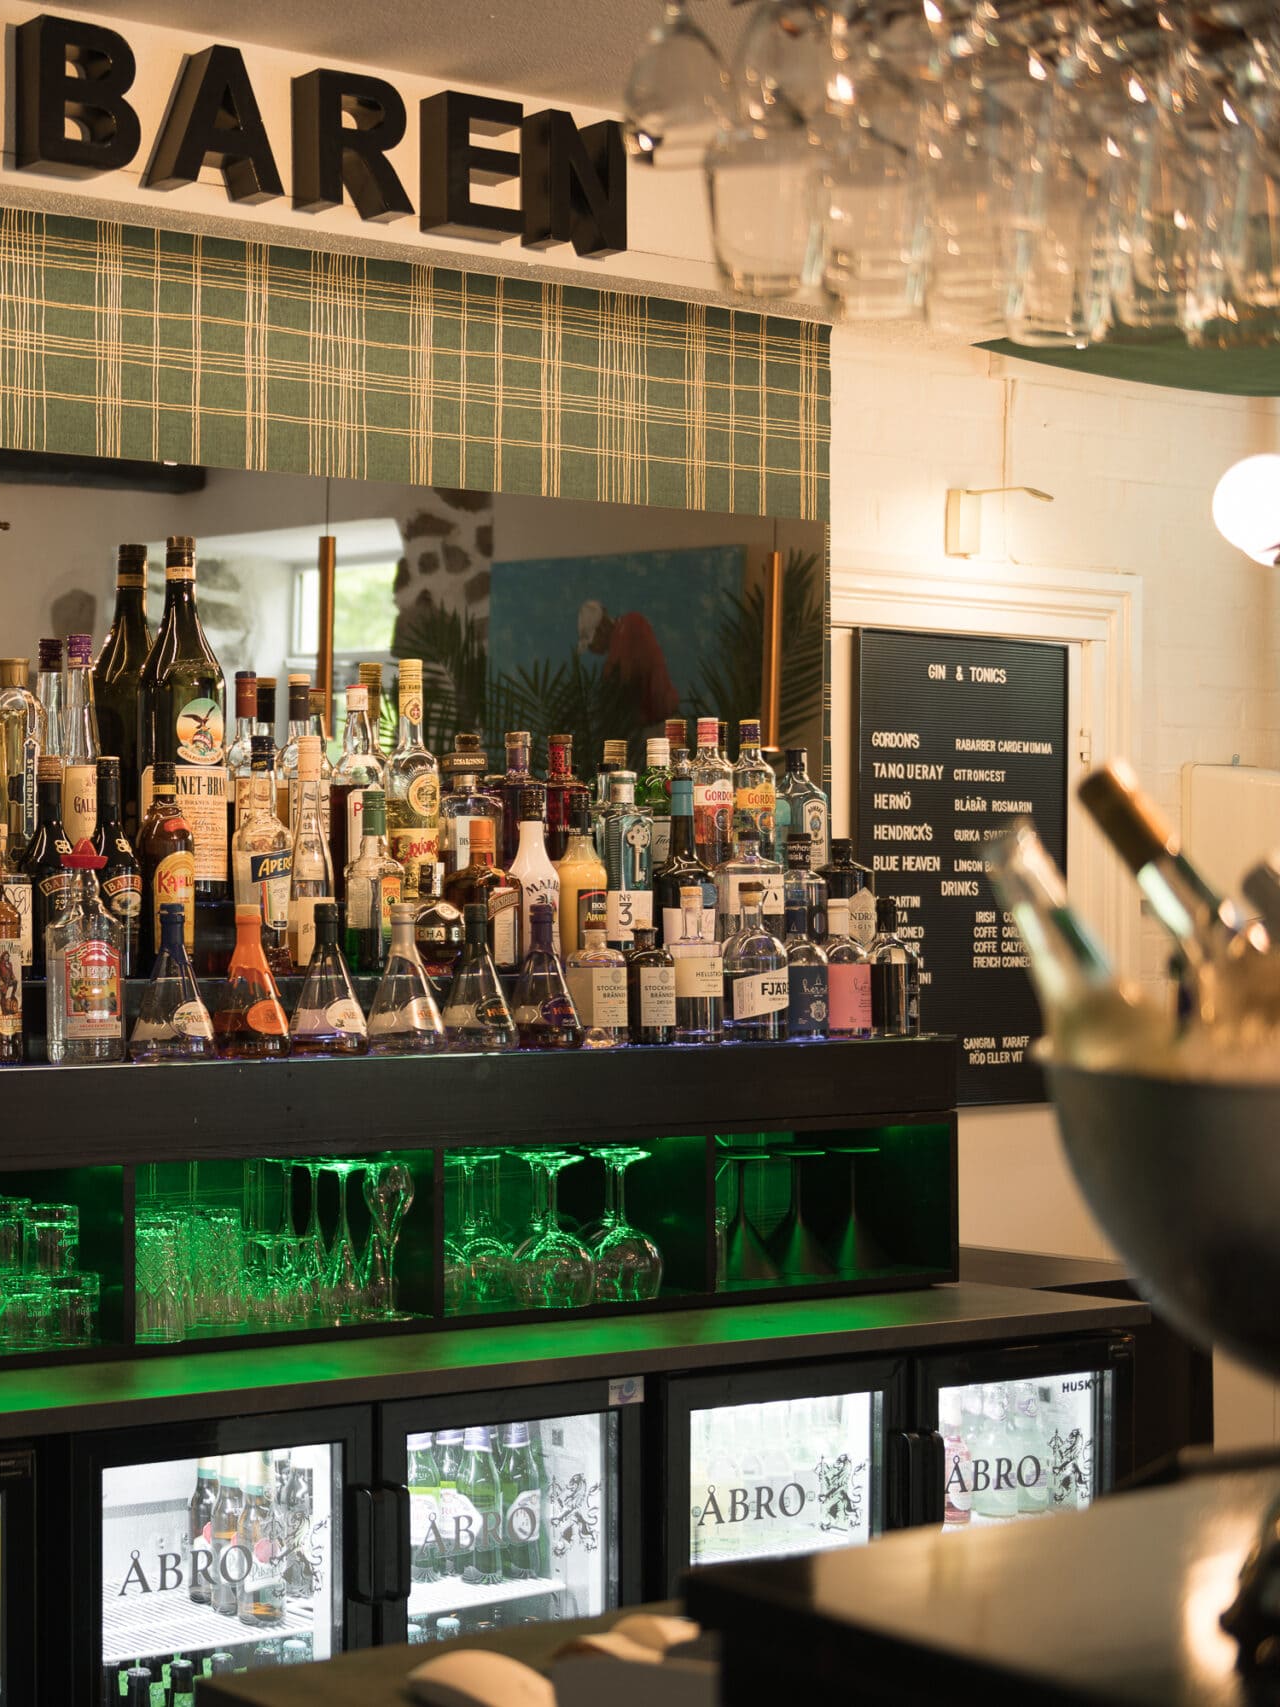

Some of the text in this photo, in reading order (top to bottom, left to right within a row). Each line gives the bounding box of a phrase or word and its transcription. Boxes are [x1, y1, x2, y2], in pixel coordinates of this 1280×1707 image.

[15, 13, 628, 258] BAREN
[928, 664, 1007, 684] GIN & TONICS
[955, 738, 996, 752] RABARBER
[874, 791, 912, 810] HERNÖ
[954, 829, 981, 842] GURKA
[873, 855, 941, 872] BLUE HEAVEN
[941, 881, 979, 897] DRINKS
[618, 902, 633, 926] 3
[976, 911, 996, 923] IRISH
[973, 926, 998, 938] COFFE
[973, 941, 997, 953] COFFE
[973, 956, 1001, 968] FRENCH
[963, 1036, 996, 1049] SANGRIA
[969, 1050, 986, 1065] RÖD
[987, 1052, 1010, 1064] ELLER
[944, 1454, 1041, 1494] ÅBRO
[697, 1482, 806, 1526] ÅBRO
[417, 1506, 537, 1557] ÅBRO
[118, 1543, 253, 1596] ÅBRO
